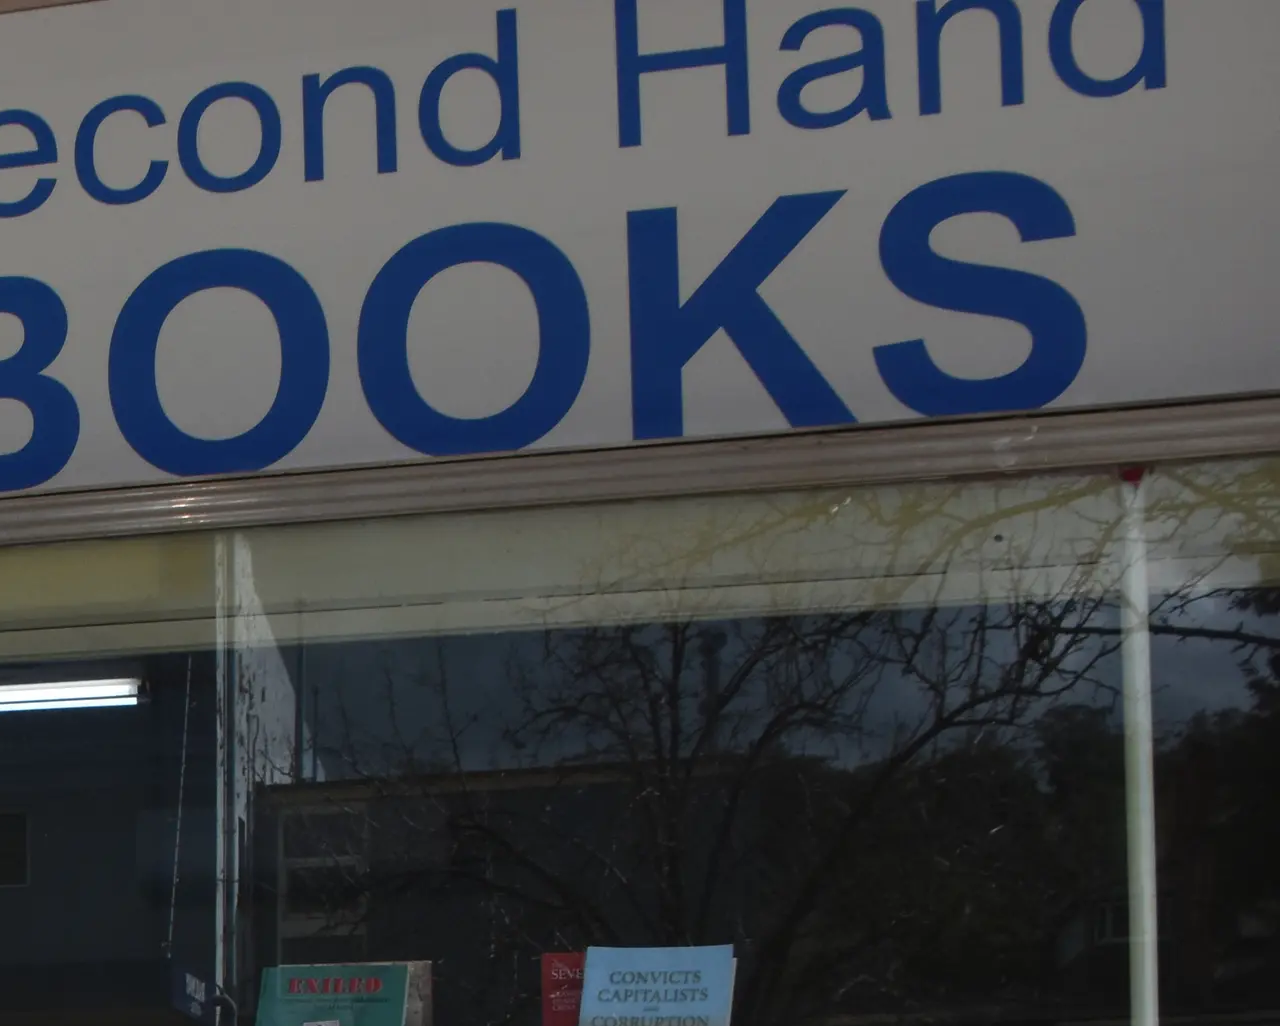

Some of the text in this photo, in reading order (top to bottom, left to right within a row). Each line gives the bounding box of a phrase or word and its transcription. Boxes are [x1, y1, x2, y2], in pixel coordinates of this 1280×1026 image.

[614, 0, 1168, 149] Hand
[550, 968, 584, 980] SEVE
[609, 969, 702, 985] CONVICTS
[288, 976, 383, 995] EXILED
[597, 987, 709, 1003] CAPITALISTS
